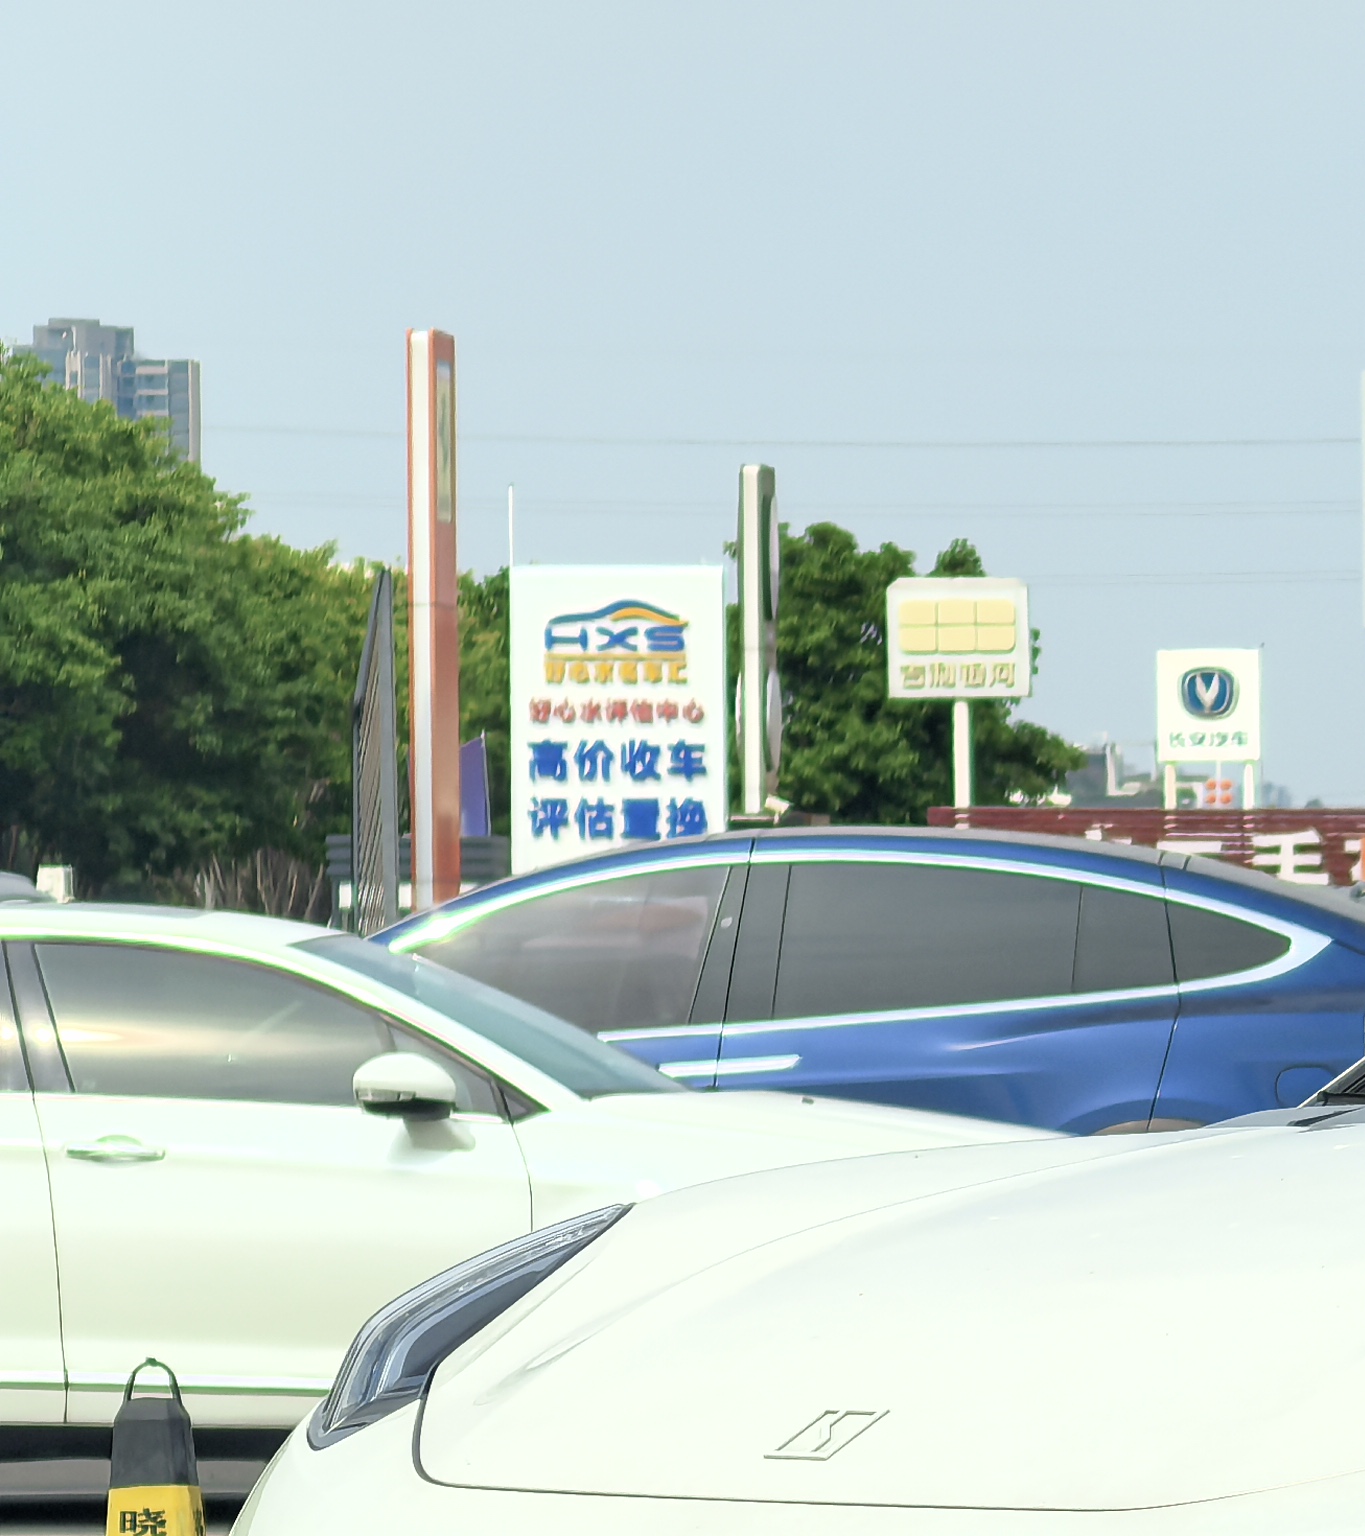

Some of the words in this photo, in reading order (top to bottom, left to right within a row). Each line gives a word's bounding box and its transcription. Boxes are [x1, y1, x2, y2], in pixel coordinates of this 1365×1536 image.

[545, 625, 686, 652] HXS
[527, 738, 707, 783] 高价收车
[527, 796, 709, 841] 评估置换
